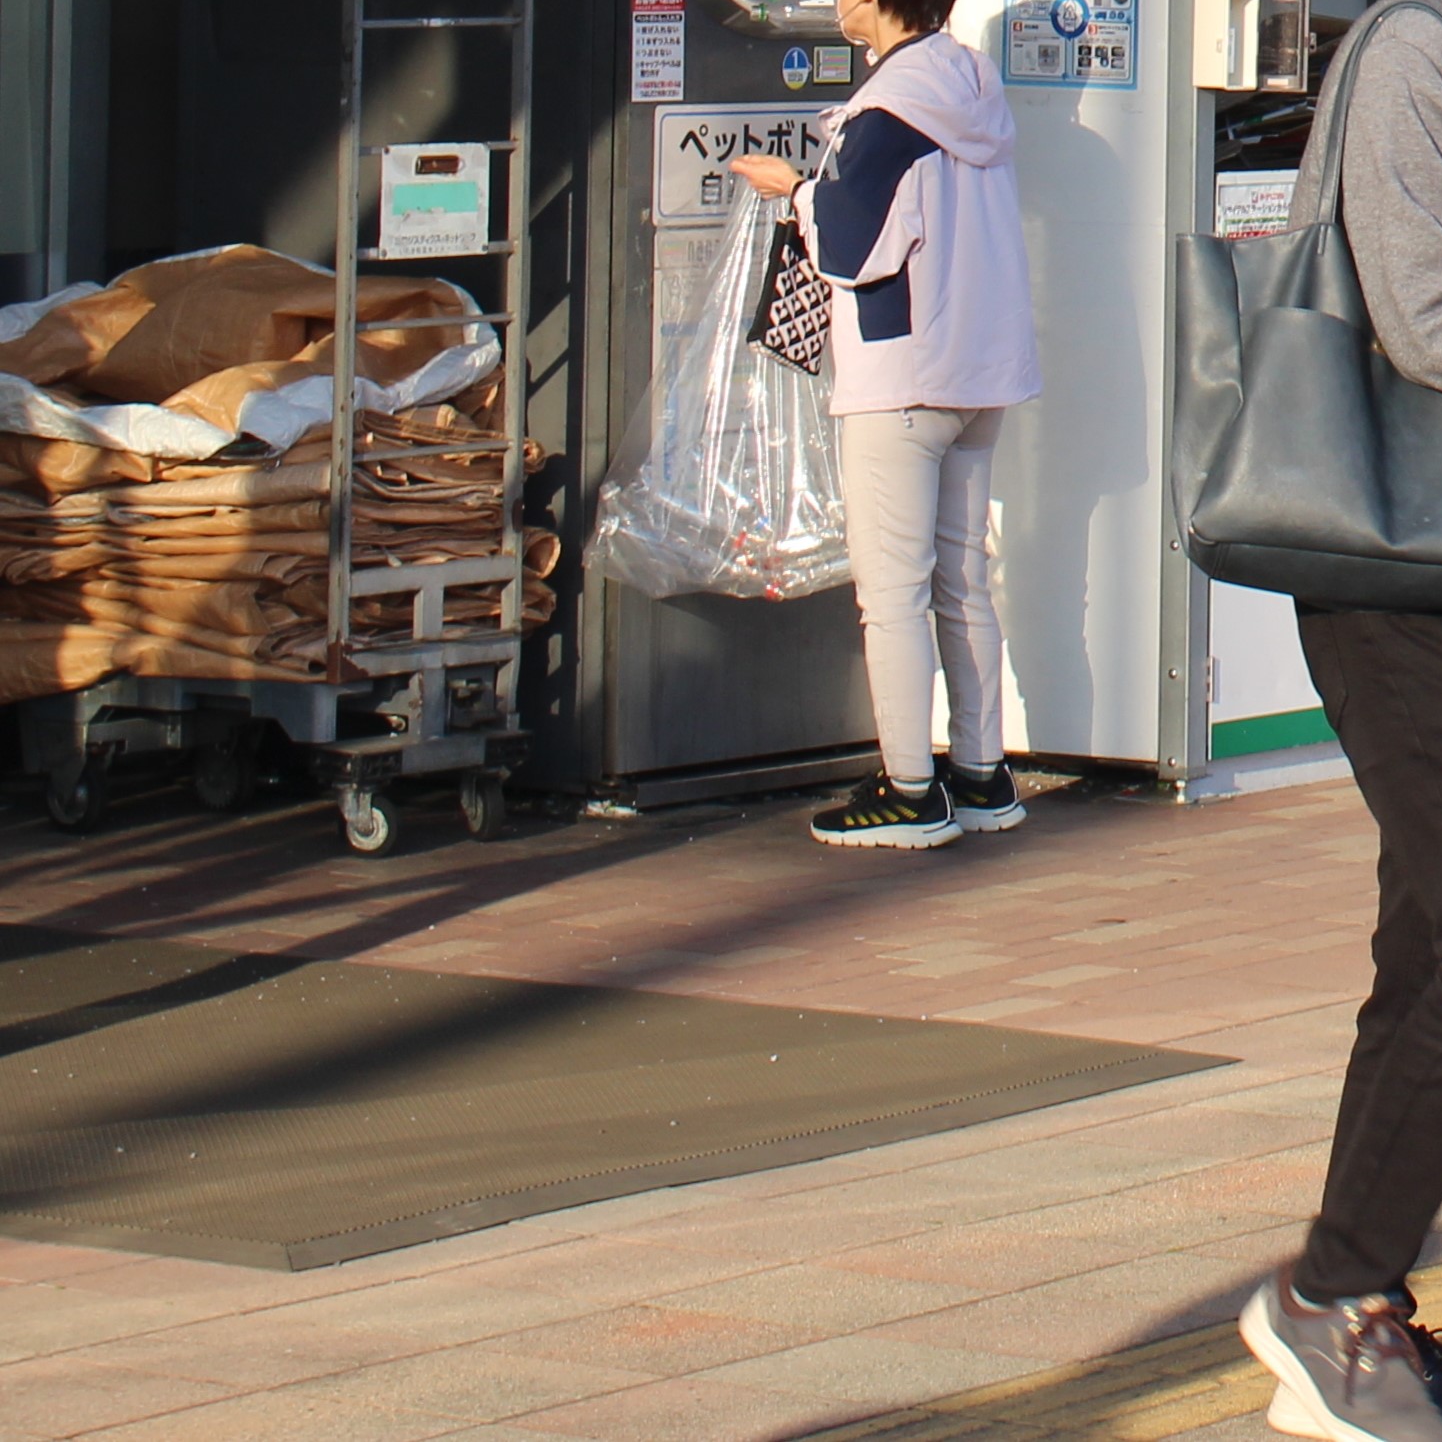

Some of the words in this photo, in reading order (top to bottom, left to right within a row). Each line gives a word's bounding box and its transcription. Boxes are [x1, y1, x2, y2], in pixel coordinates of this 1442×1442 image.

[792, 51, 799, 68] 1
[680, 120, 820, 162] ペットボト
